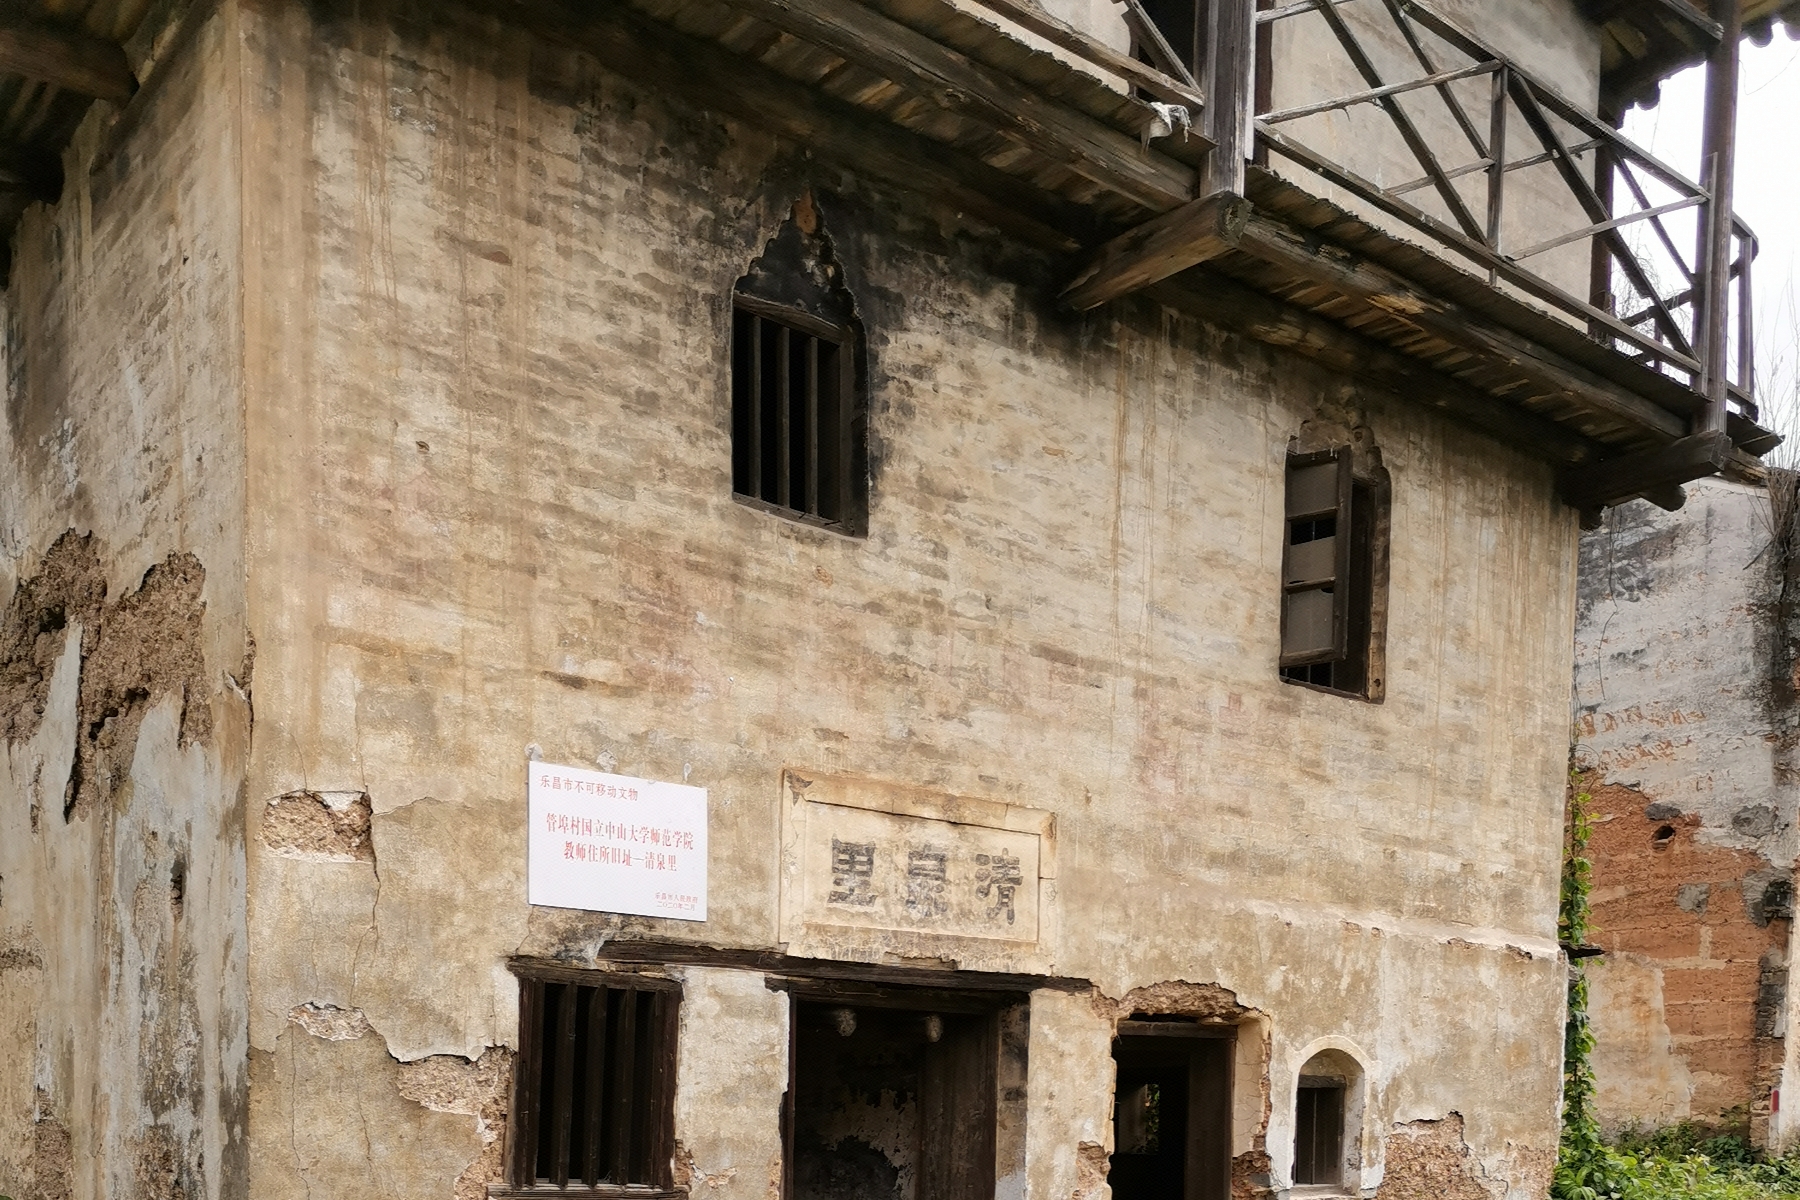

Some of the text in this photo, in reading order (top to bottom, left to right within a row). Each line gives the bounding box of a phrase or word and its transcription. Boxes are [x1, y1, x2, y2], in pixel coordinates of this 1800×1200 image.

[540, 774, 639, 802] 乐昌市不可移动文物
[546, 812, 694, 851] 管埠村国立中山大学师范学院
